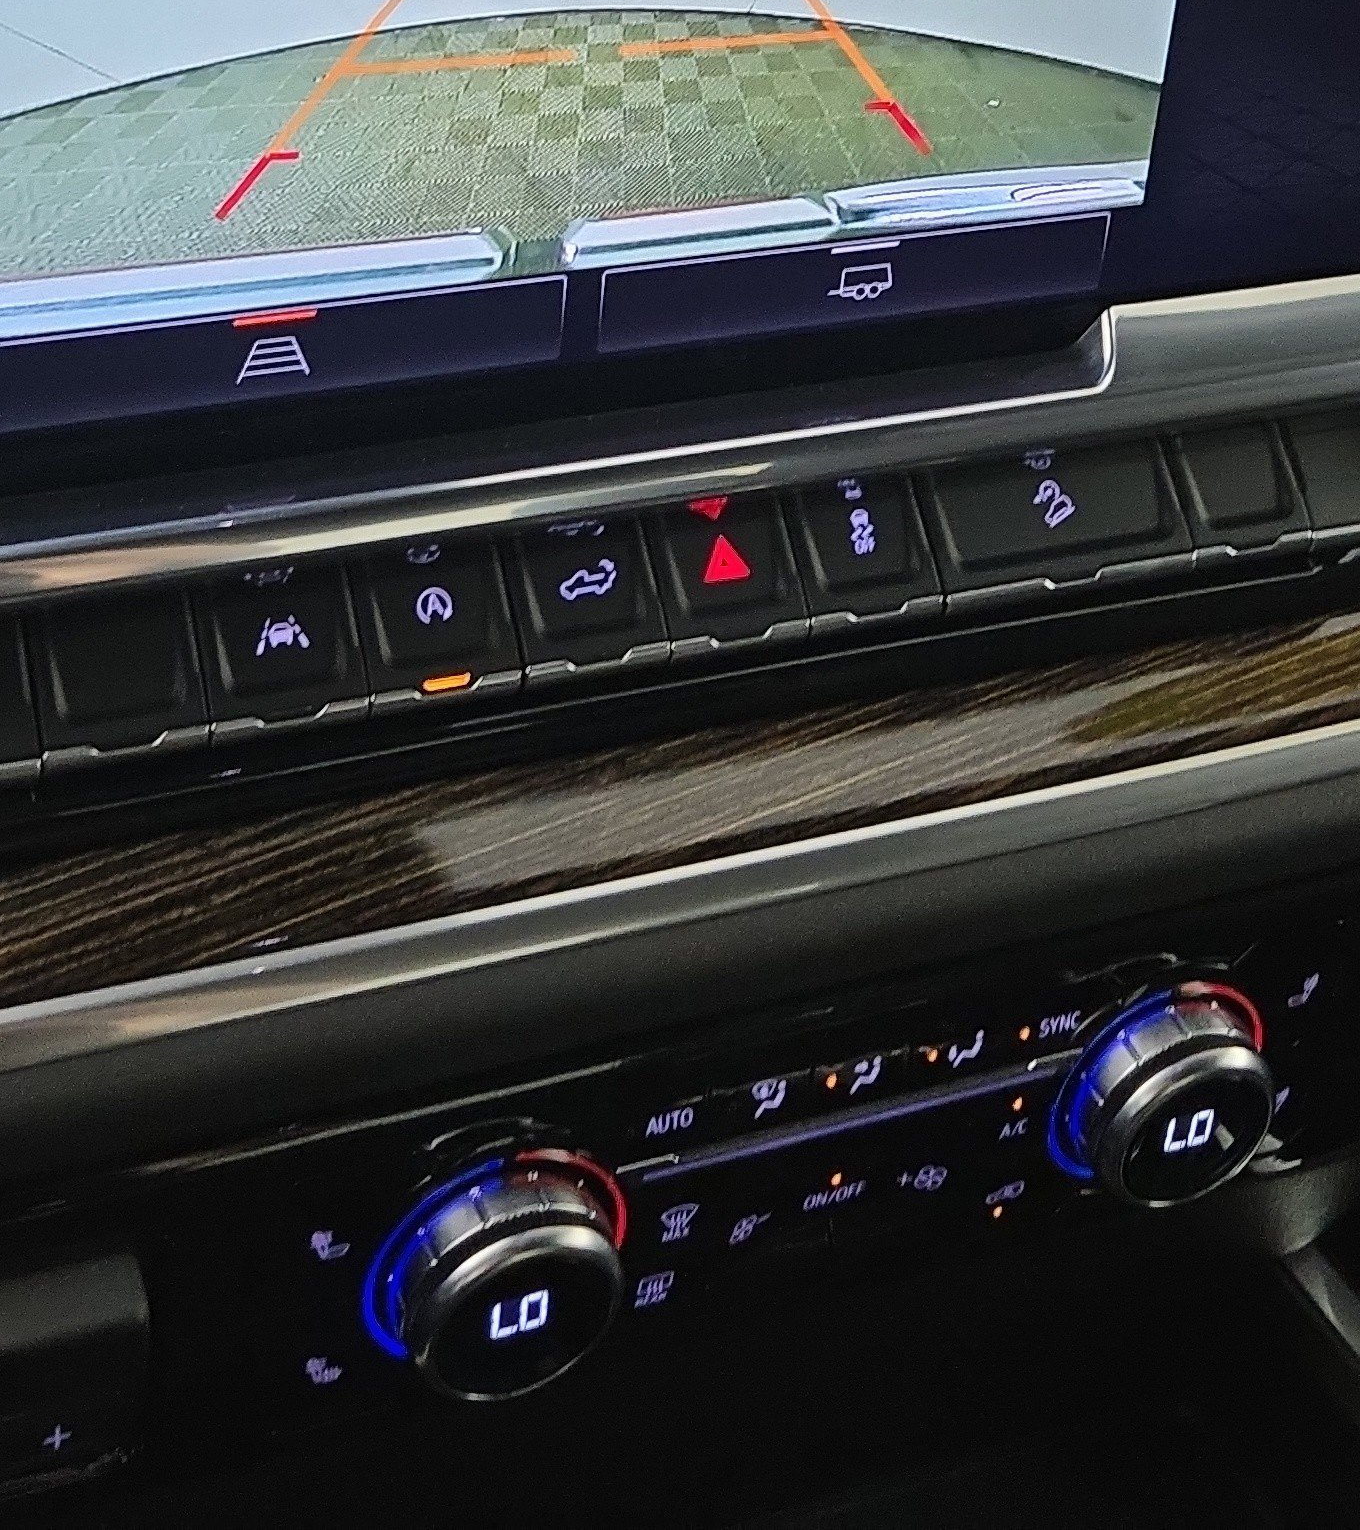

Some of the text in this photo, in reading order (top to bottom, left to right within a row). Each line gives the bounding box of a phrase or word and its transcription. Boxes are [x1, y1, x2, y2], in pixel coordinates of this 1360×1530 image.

[1039, 1010, 1082, 1038] SYNC
[645, 1107, 694, 1138] AUTO
[998, 1118, 1028, 1141] A/C
[802, 1179, 867, 1211] ON/OFF
